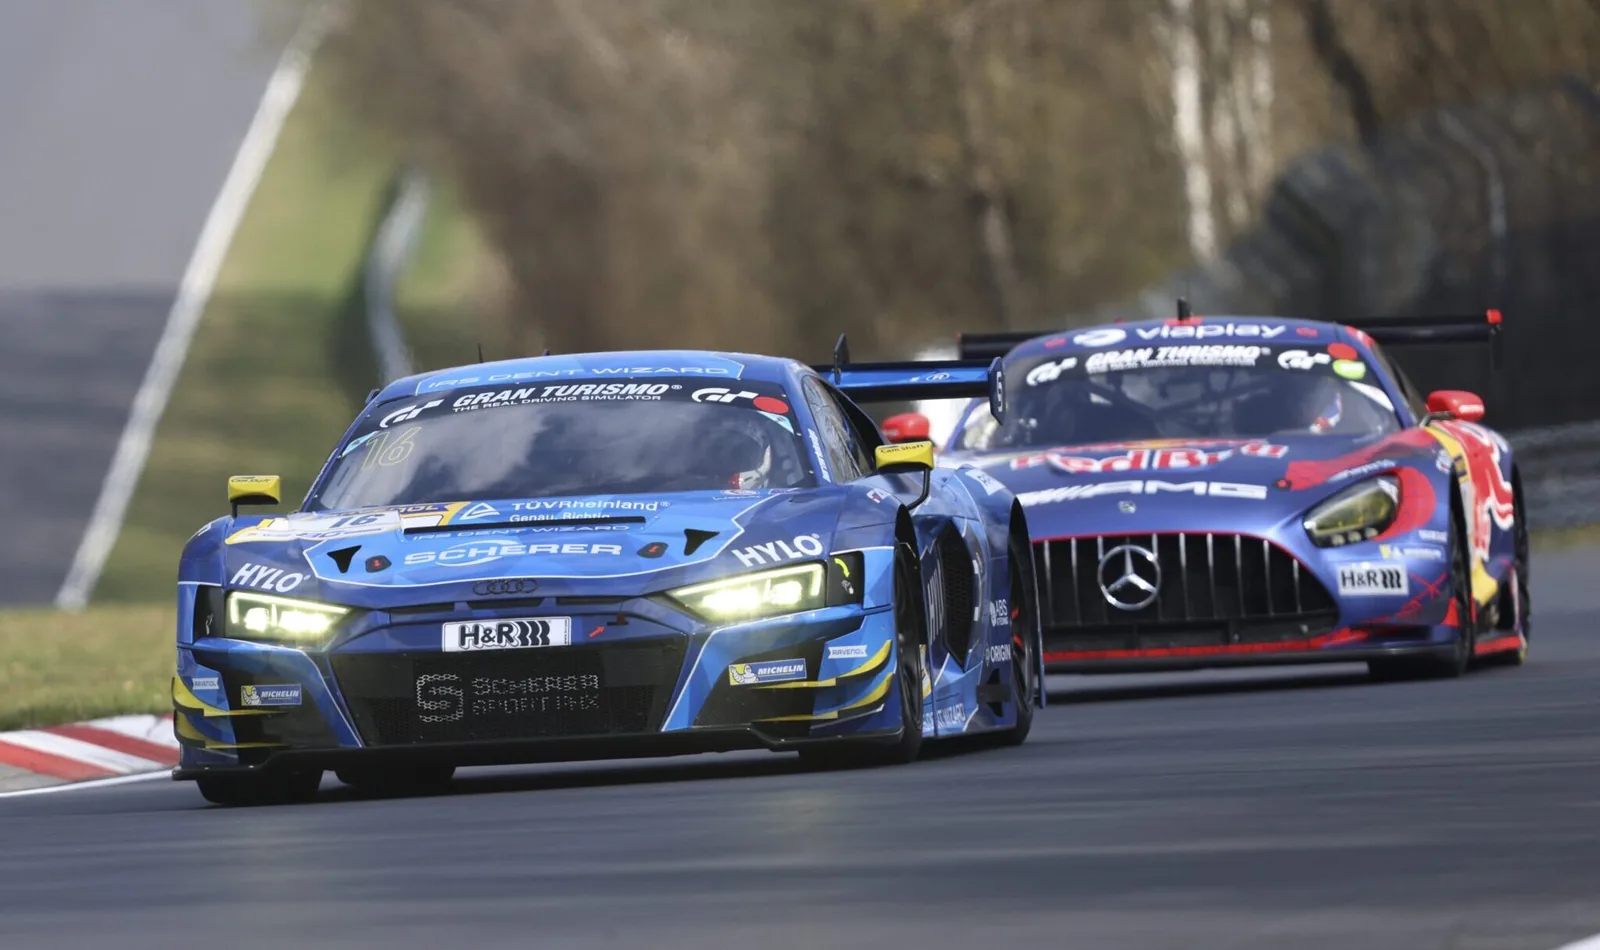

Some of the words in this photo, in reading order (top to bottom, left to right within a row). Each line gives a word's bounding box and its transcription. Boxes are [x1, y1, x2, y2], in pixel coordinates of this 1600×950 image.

[1136, 323, 1286, 340] viaplay
[1085, 347, 1154, 369] GRAN
[428, 377, 479, 389] IRS
[488, 369, 586, 382] DENT
[591, 366, 729, 375] WIZARD
[453, 387, 536, 408] GRAN
[453, 405, 479, 413] THE
[361, 426, 422, 470] 16
[329, 513, 386, 529] 16
[404, 543, 622, 565] SCHERER
[1340, 570, 1380, 588] H&R
[458, 622, 519, 650] H&R
[757, 664, 804, 676] MICHELIN
[260, 690, 300, 698] MICHELIN
[472, 674, 600, 696] SCHERER
